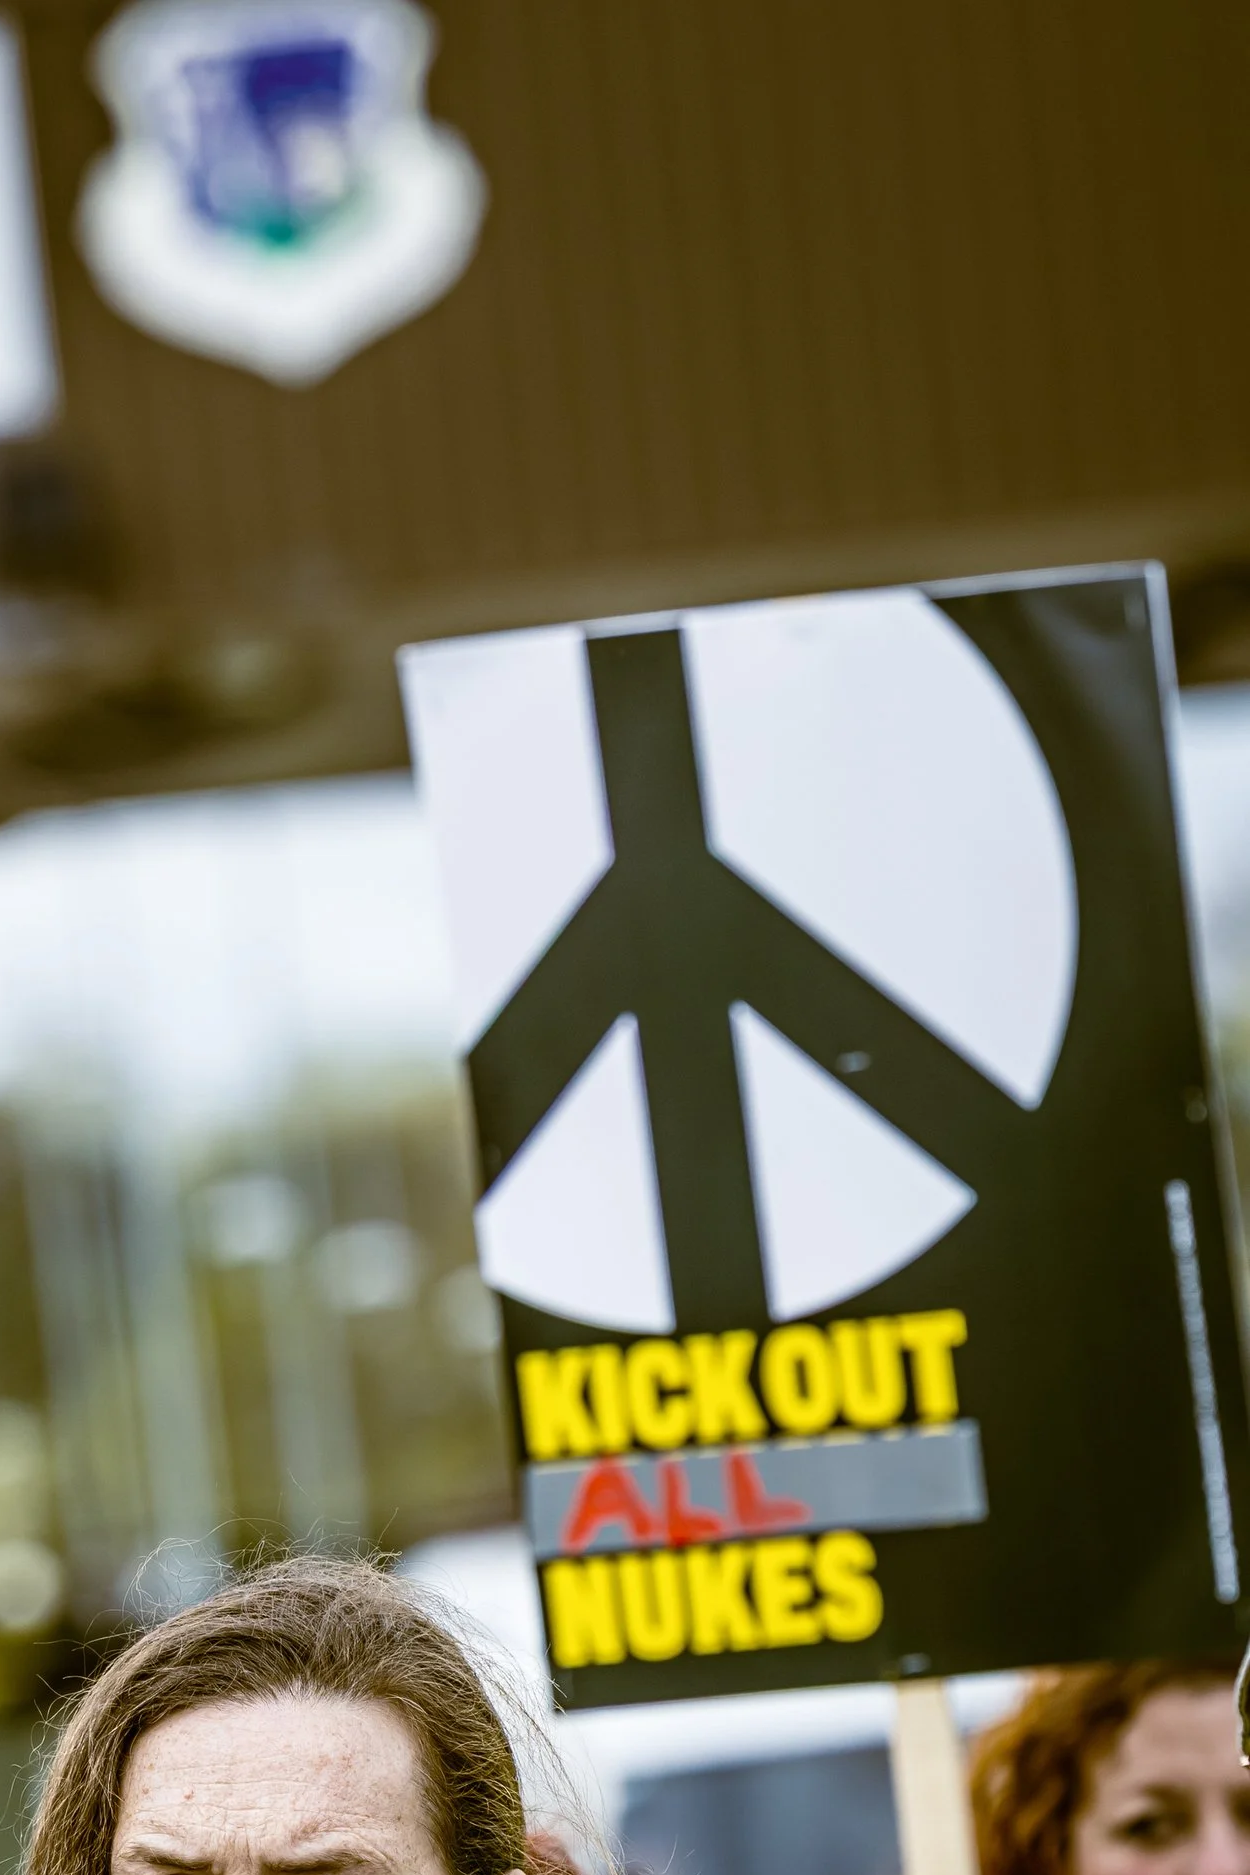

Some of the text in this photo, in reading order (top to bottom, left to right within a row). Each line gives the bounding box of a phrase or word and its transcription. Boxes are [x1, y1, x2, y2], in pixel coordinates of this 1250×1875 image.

[516, 1308, 967, 1460] KICK OUT
[561, 1446, 814, 1552] ALL
[544, 1530, 884, 1668] NUKES
